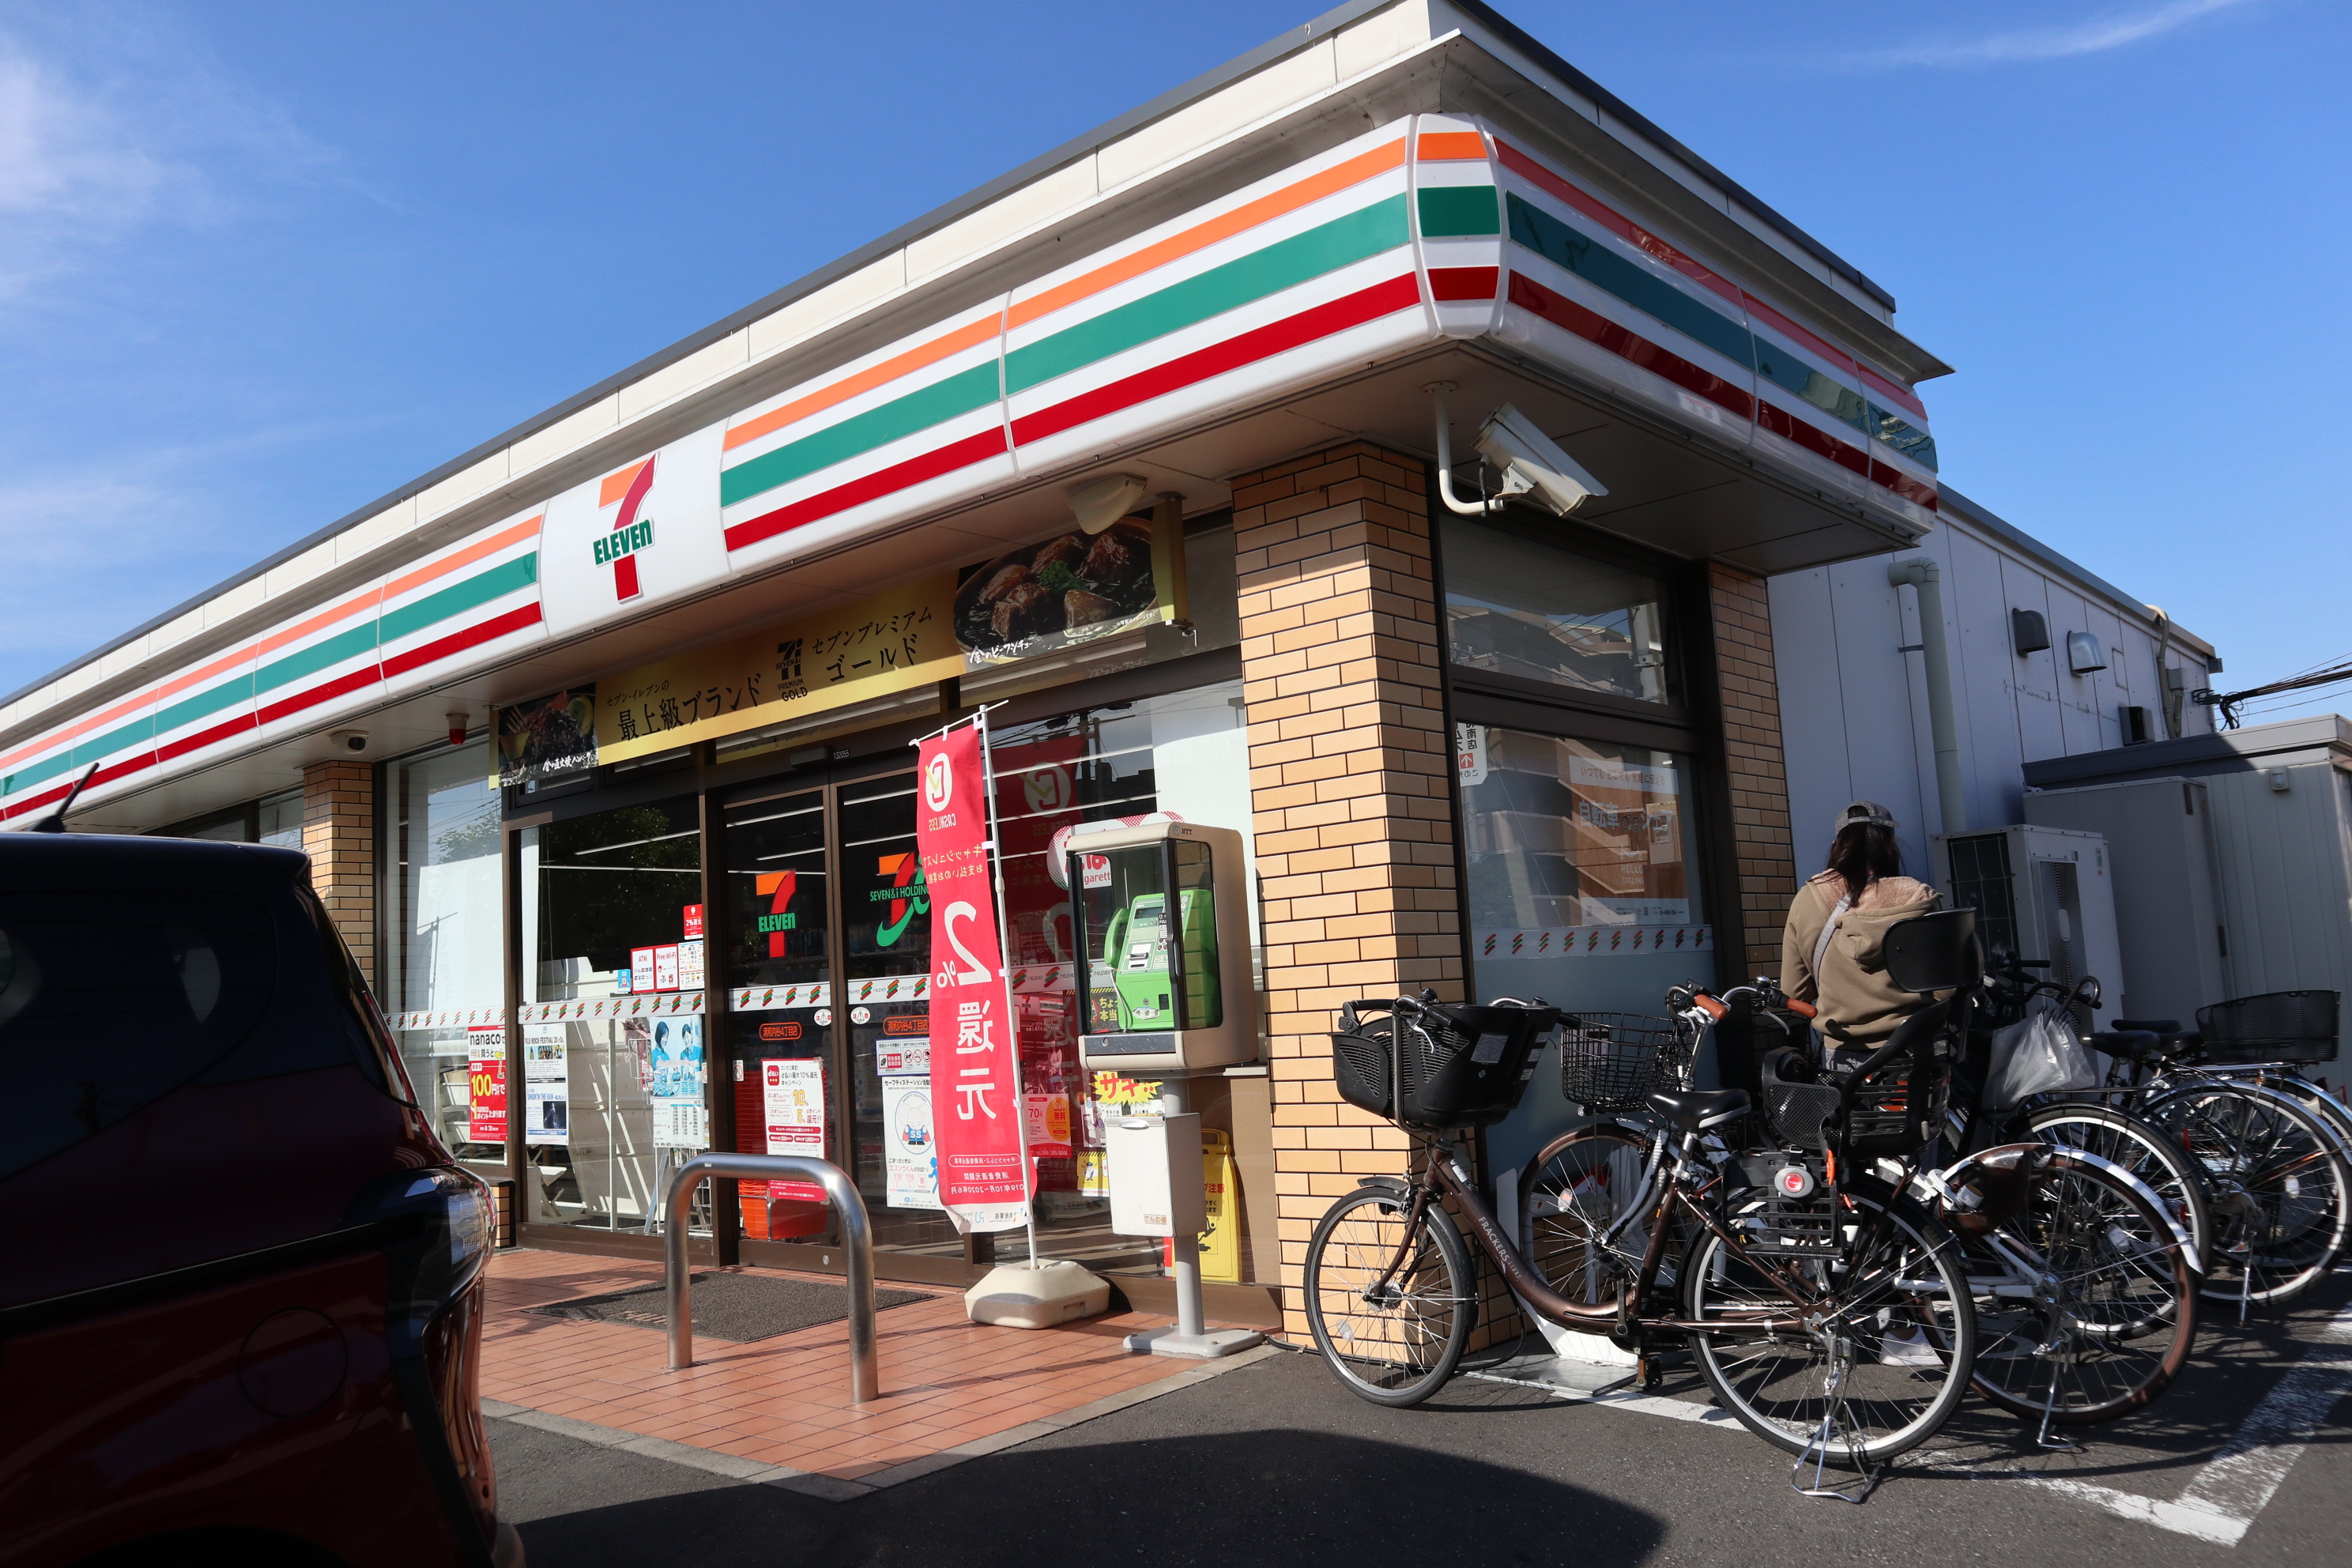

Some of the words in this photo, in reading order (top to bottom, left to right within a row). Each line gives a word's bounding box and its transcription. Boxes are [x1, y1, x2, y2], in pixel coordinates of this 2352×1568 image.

[812, 606, 932, 655] セブンプレミアム
[826, 633, 918, 682] ゴールド
[778, 678, 805, 691] PREMIUM
[782, 686, 808, 702] GOLD
[617, 673, 761, 741] 最上級ブランド
[833, 750, 850, 760] 132055
[1578, 799, 1620, 831] 自転車
[1621, 865, 1644, 874] HELLO
[1084, 873, 1111, 884] garett
[1099, 1009, 1118, 1021] 本当
[910, 1129, 922, 1139] SS
[1478, 1216, 1510, 1263] FRACKERS
